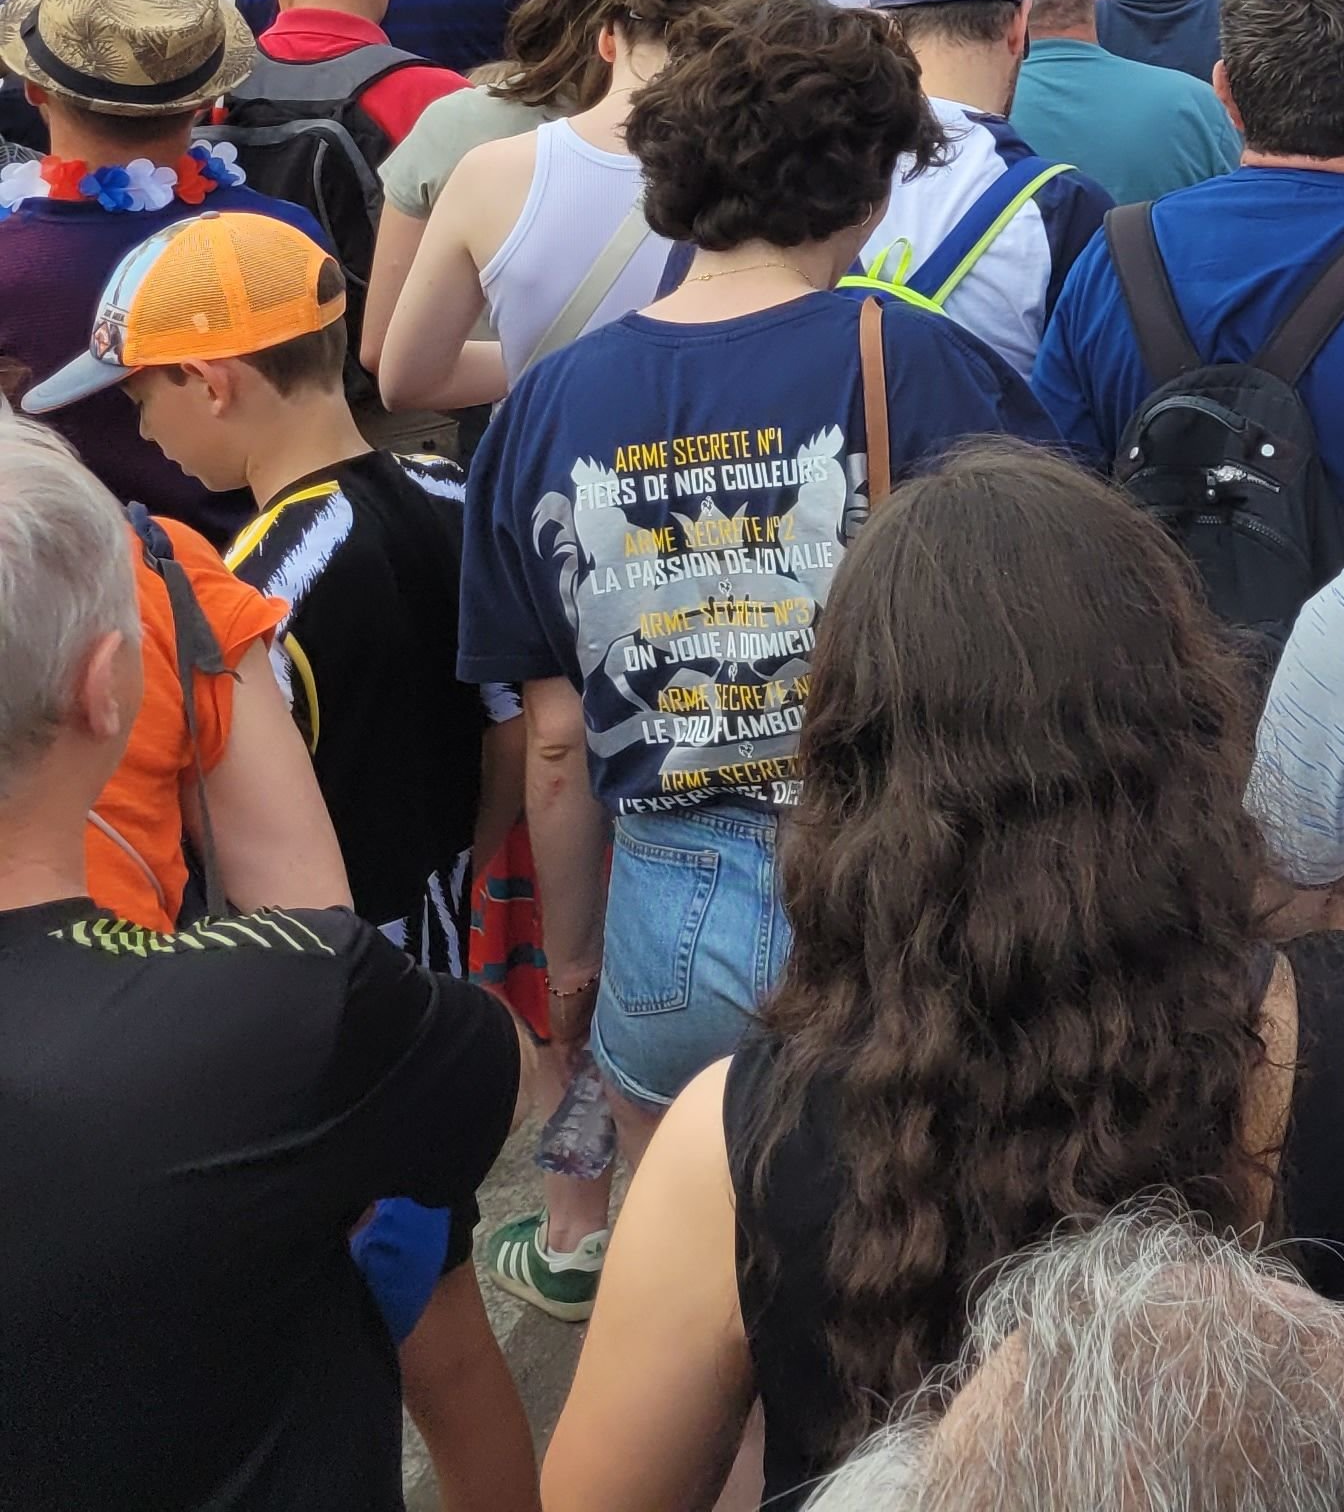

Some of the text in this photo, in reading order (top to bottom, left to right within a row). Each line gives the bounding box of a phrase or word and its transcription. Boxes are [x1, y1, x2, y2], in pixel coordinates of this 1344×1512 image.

[616, 441, 668, 473] ARME
[673, 430, 750, 465] SECRETE
[577, 455, 829, 512] FIERS DE NOS COULEURS
[624, 525, 676, 558] ARME
[684, 516, 762, 550] SECRETE
[589, 565, 622, 595] LA
[625, 550, 722, 589] PASSION
[724, 547, 753, 576] DE
[640, 609, 696, 640] ARME
[701, 599, 769, 628] SECRETE
[624, 643, 657, 672] ON
[665, 631, 723, 665] JOUE
[727, 631, 737, 659] A
[658, 683, 710, 713] ARME
[714, 679, 790, 712] SECRETE
[641, 704, 806, 748] LE COQ FLAMBO
